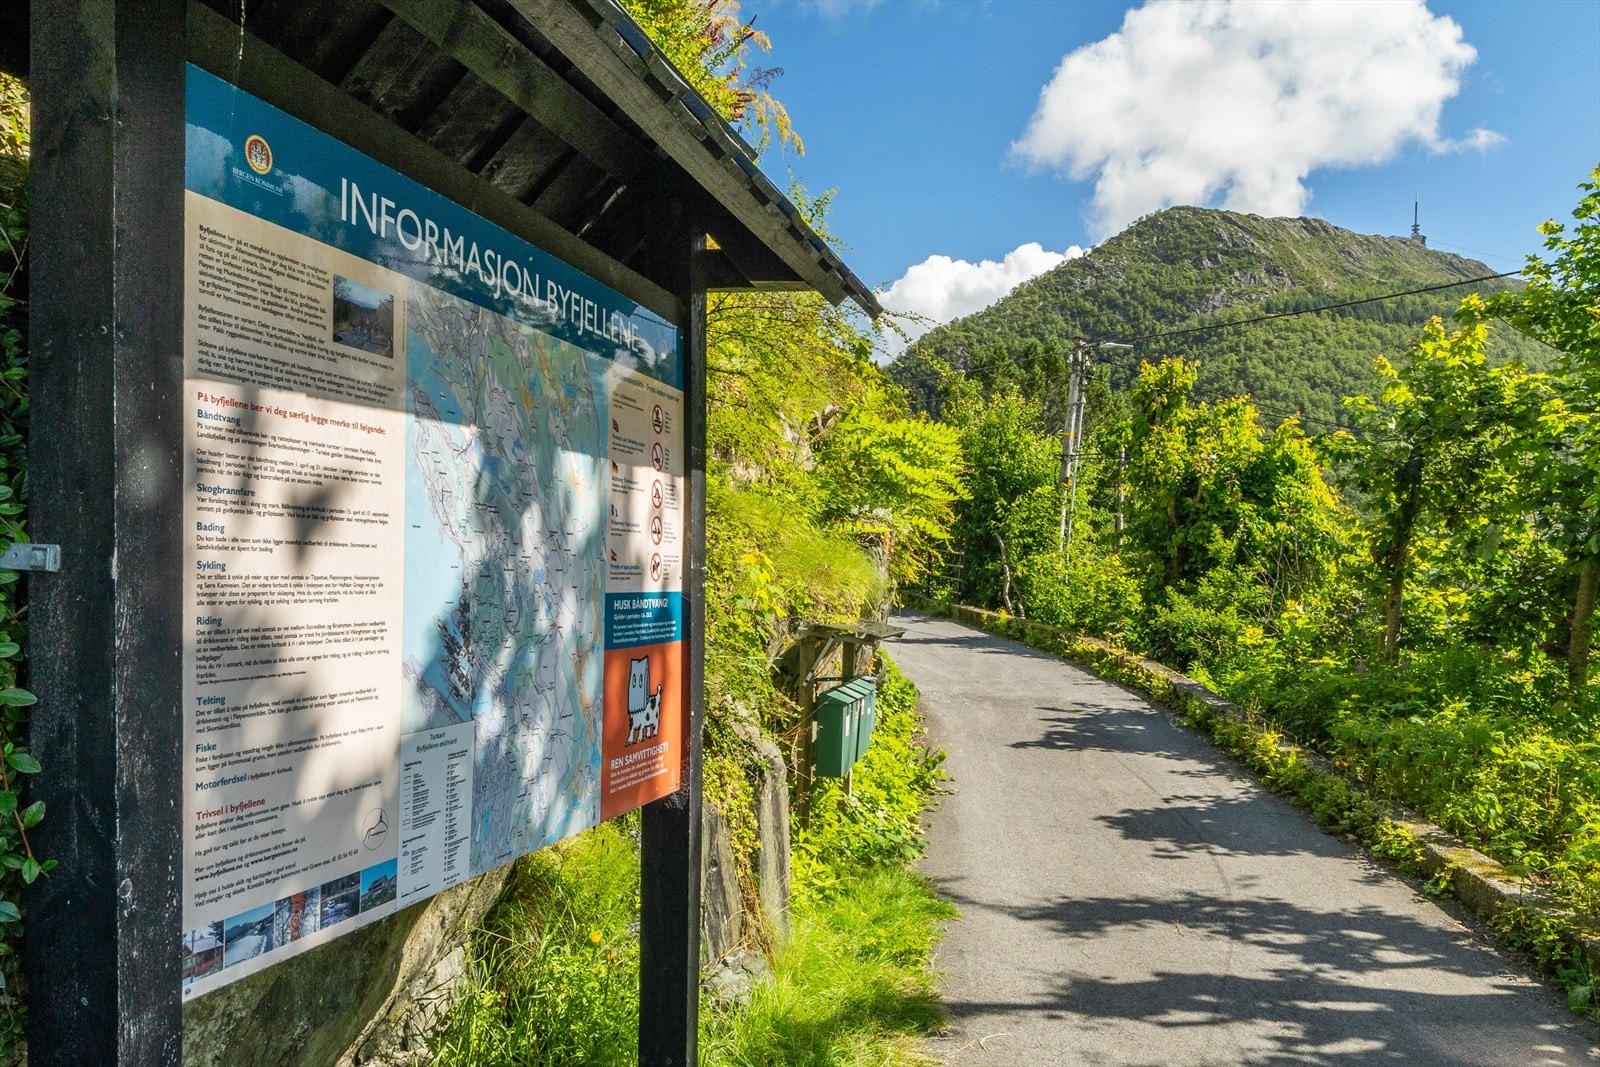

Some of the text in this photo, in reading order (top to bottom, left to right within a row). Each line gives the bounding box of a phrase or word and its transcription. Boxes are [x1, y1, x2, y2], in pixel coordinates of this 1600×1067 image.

[232, 167, 284, 195] BERGEN KOMMUNE
[341, 178, 639, 352] INFORMASJON BYFJELLENE
[197, 391, 208, 401] På
[210, 393, 248, 409] byfjellene
[250, 401, 263, 412] ber
[265, 405, 272, 413] vi
[274, 406, 287, 418] deg
[289, 410, 309, 422] særlig
[310, 413, 328, 425] legge
[329, 418, 350, 428] merke
[359, 422, 385, 435] følgende:
[197, 409, 240, 427] Båndtvang
[196, 482, 255, 496] Skogbrannfare
[196, 522, 224, 534] Bading
[196, 560, 226, 571] Sykling
[614, 597, 668, 610] HUSK BÅNDTVANG!
[196, 616, 222, 626] Riding
[196, 695, 225, 706] Telting
[430, 732, 445, 740] Turkart
[196, 742, 216, 753] Fiske
[416, 743, 438, 753] Byfjellene
[610, 758, 623, 770] REN
[625, 741, 668, 765] SAMVITTIGHET!
[195, 772, 246, 791] Motorferdsel
[250, 770, 270, 780] byfjellene
[276, 764, 293, 774] forbudt.
[196, 806, 223, 820] Trivsel
[230, 798, 265, 813] byfjellene
